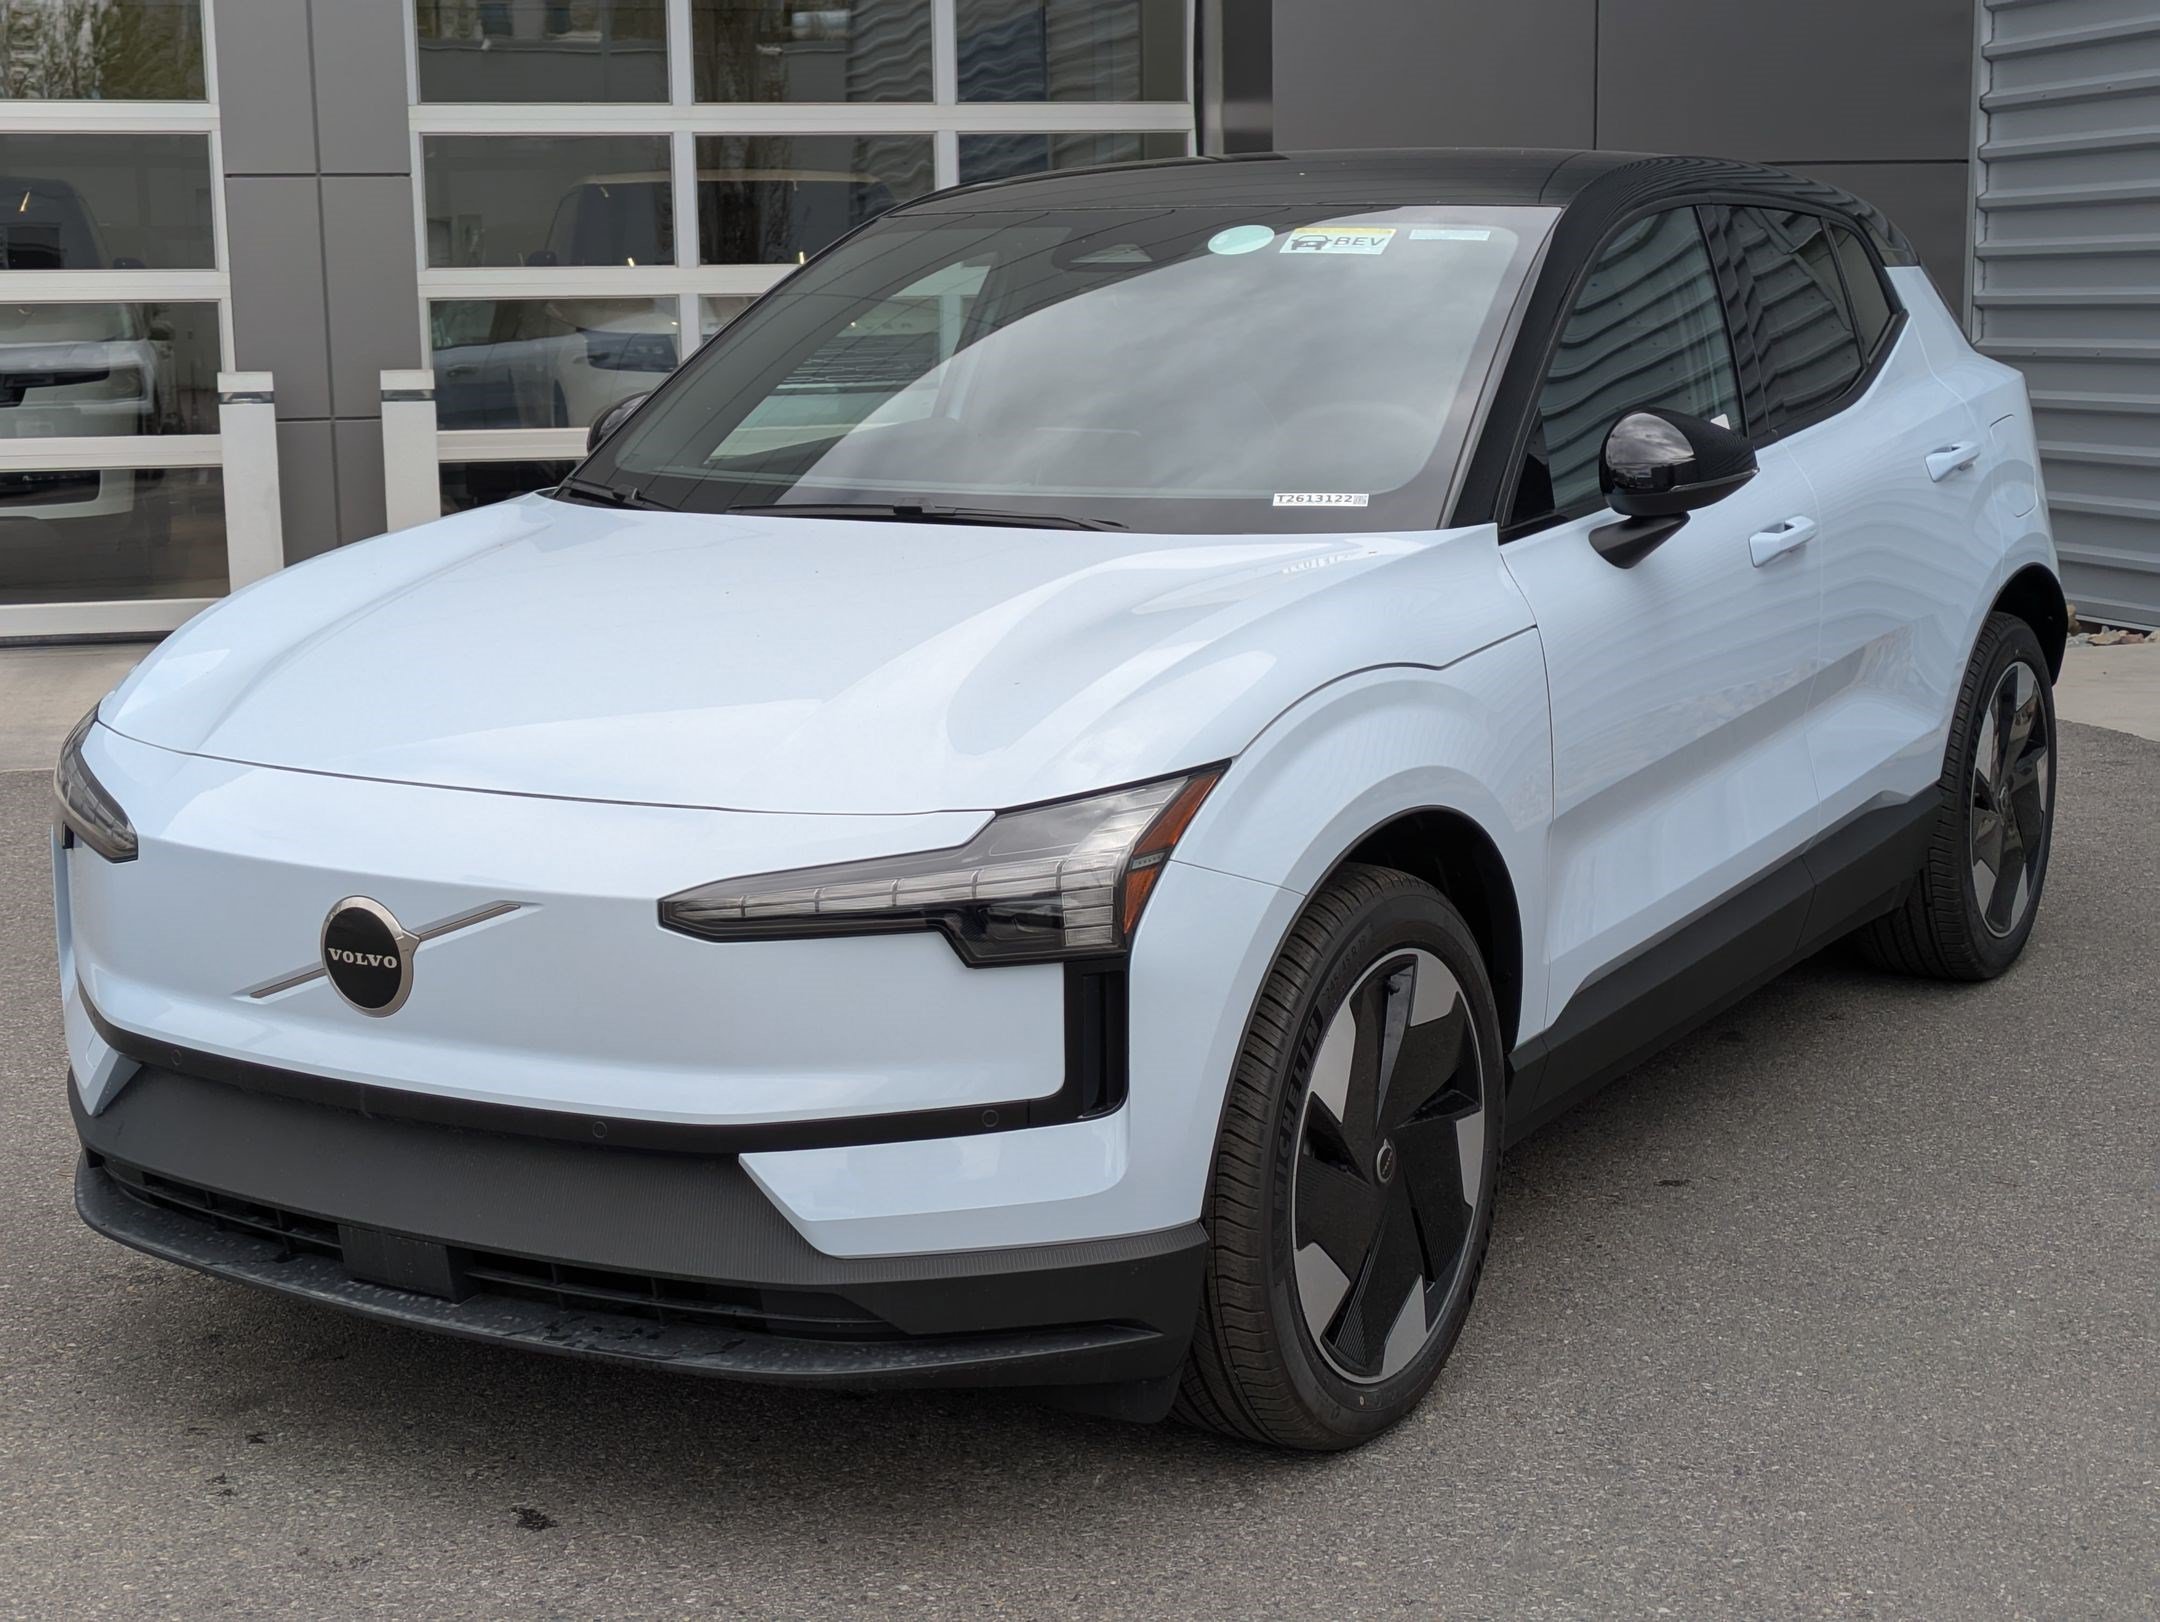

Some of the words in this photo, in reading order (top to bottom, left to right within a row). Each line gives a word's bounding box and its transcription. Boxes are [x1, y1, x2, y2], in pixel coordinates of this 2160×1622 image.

[1334, 236, 1386, 247] BEV
[1276, 494, 1353, 504] T2613122
[327, 947, 398, 969] VOLVO
[1274, 1004, 1324, 1211] MICHELIN
